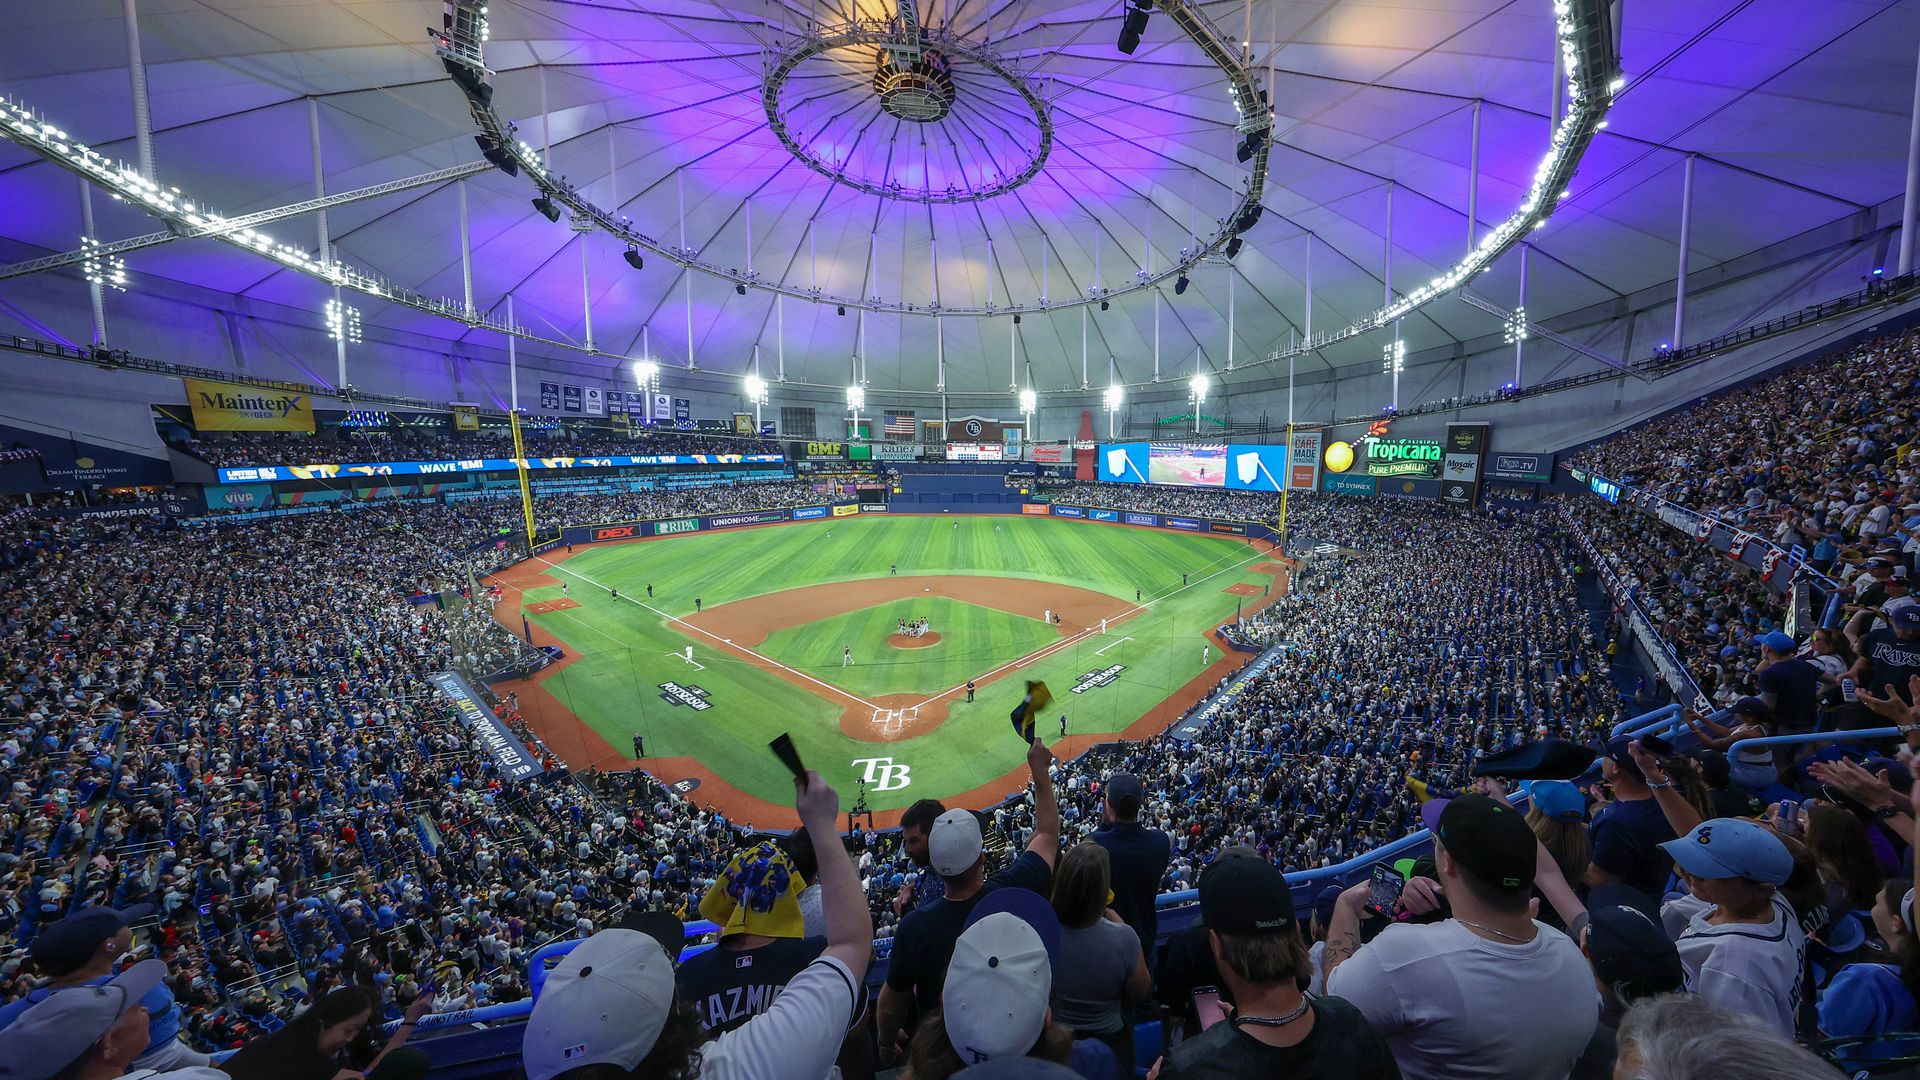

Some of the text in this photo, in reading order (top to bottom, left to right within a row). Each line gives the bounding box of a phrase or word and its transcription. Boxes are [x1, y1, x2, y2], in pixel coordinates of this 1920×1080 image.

[199, 392, 302, 418] MaintenX
[807, 442, 841, 455] GMF
[1295, 439, 1317, 449] CARE
[1364, 437, 1441, 461] Tropicana
[1293, 449, 1316, 458] MADE
[630, 456, 657, 464] WAVE
[1447, 459, 1475, 469] Mosaic
[419, 463, 457, 474] WAVE
[1368, 462, 1428, 474] PURE PREMIUM
[1346, 482, 1371, 490] SYNNEX
[796, 510, 821, 518] Spectrum
[597, 526, 635, 540] DEX
[466, 709, 484, 721] TO
[472, 716, 509, 750] TROPICANA
[495, 746, 522, 766] FIELD
[851, 757, 912, 792] TB
[452, 1010, 475, 1021] RAIL
